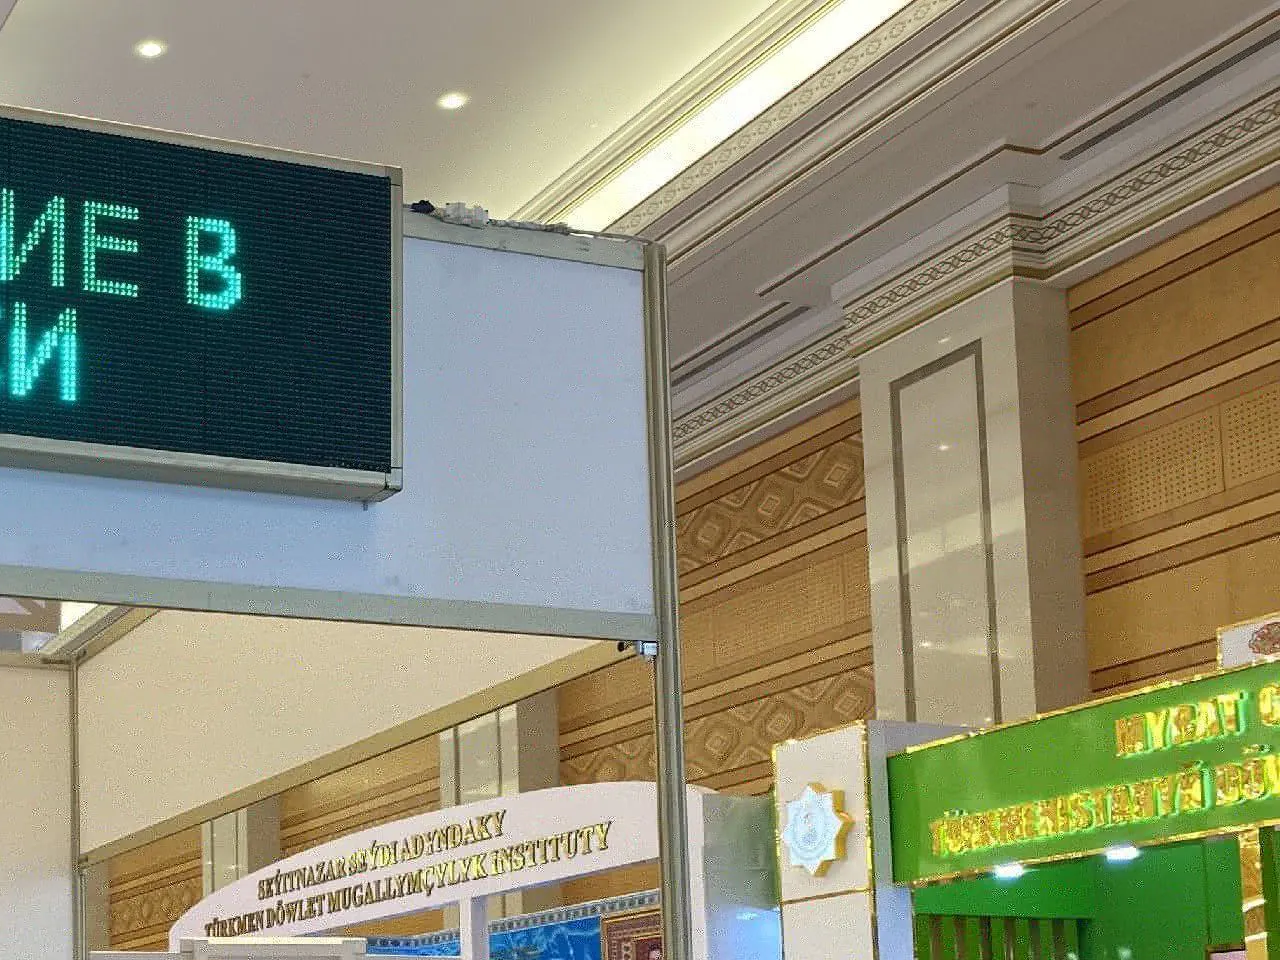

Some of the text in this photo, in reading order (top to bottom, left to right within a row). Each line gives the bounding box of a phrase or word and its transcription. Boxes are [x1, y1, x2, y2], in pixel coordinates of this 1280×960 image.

[186, 216, 242, 310] В
[399, 809, 507, 862] ADYNDAKY
[490, 821, 613, 877] INSTITUTY
